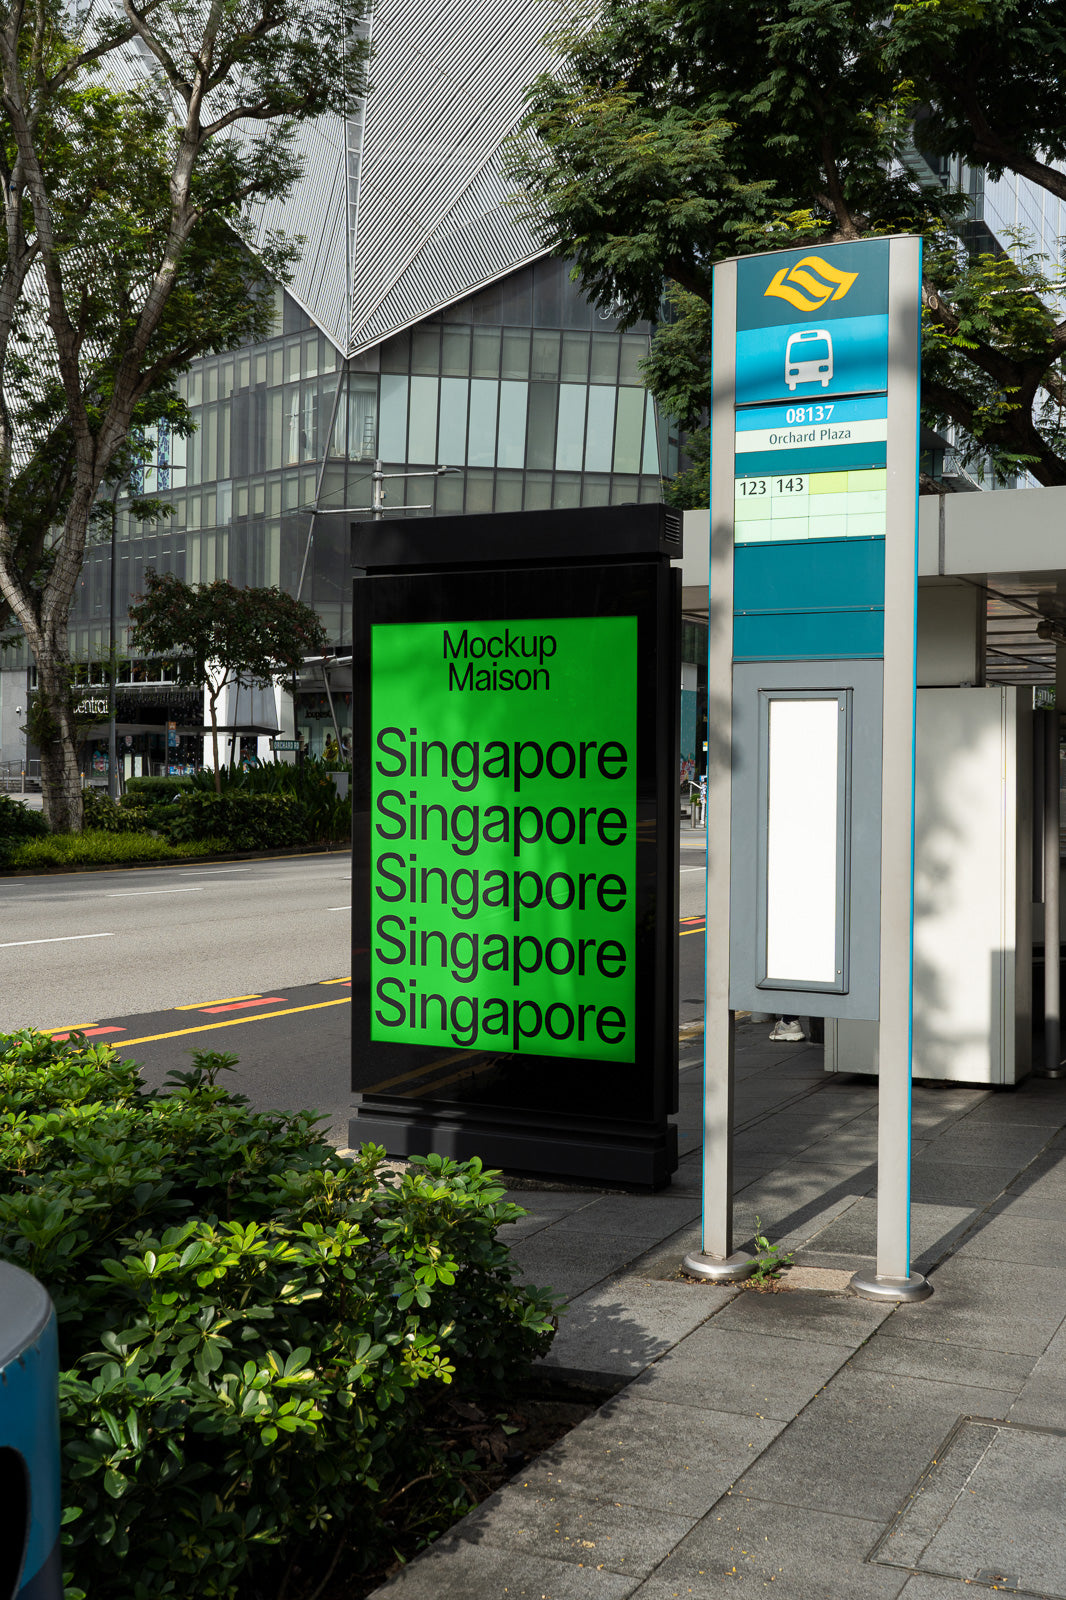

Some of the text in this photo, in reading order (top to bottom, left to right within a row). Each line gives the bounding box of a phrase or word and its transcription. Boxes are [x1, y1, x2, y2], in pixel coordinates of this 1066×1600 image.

[785, 404, 835, 424] 08137
[769, 427, 851, 445] Orchard Plaza
[740, 477, 804, 496] 123 143
[443, 628, 557, 666] Mockup
[448, 661, 551, 692] Maison
[273, 741, 293, 750] ORCHARD
[375, 726, 628, 792] Singapore
[375, 789, 628, 857] Singapore
[375, 852, 627, 922] Singapore
[375, 914, 627, 987] Singapore
[375, 976, 627, 1051] Singapore
